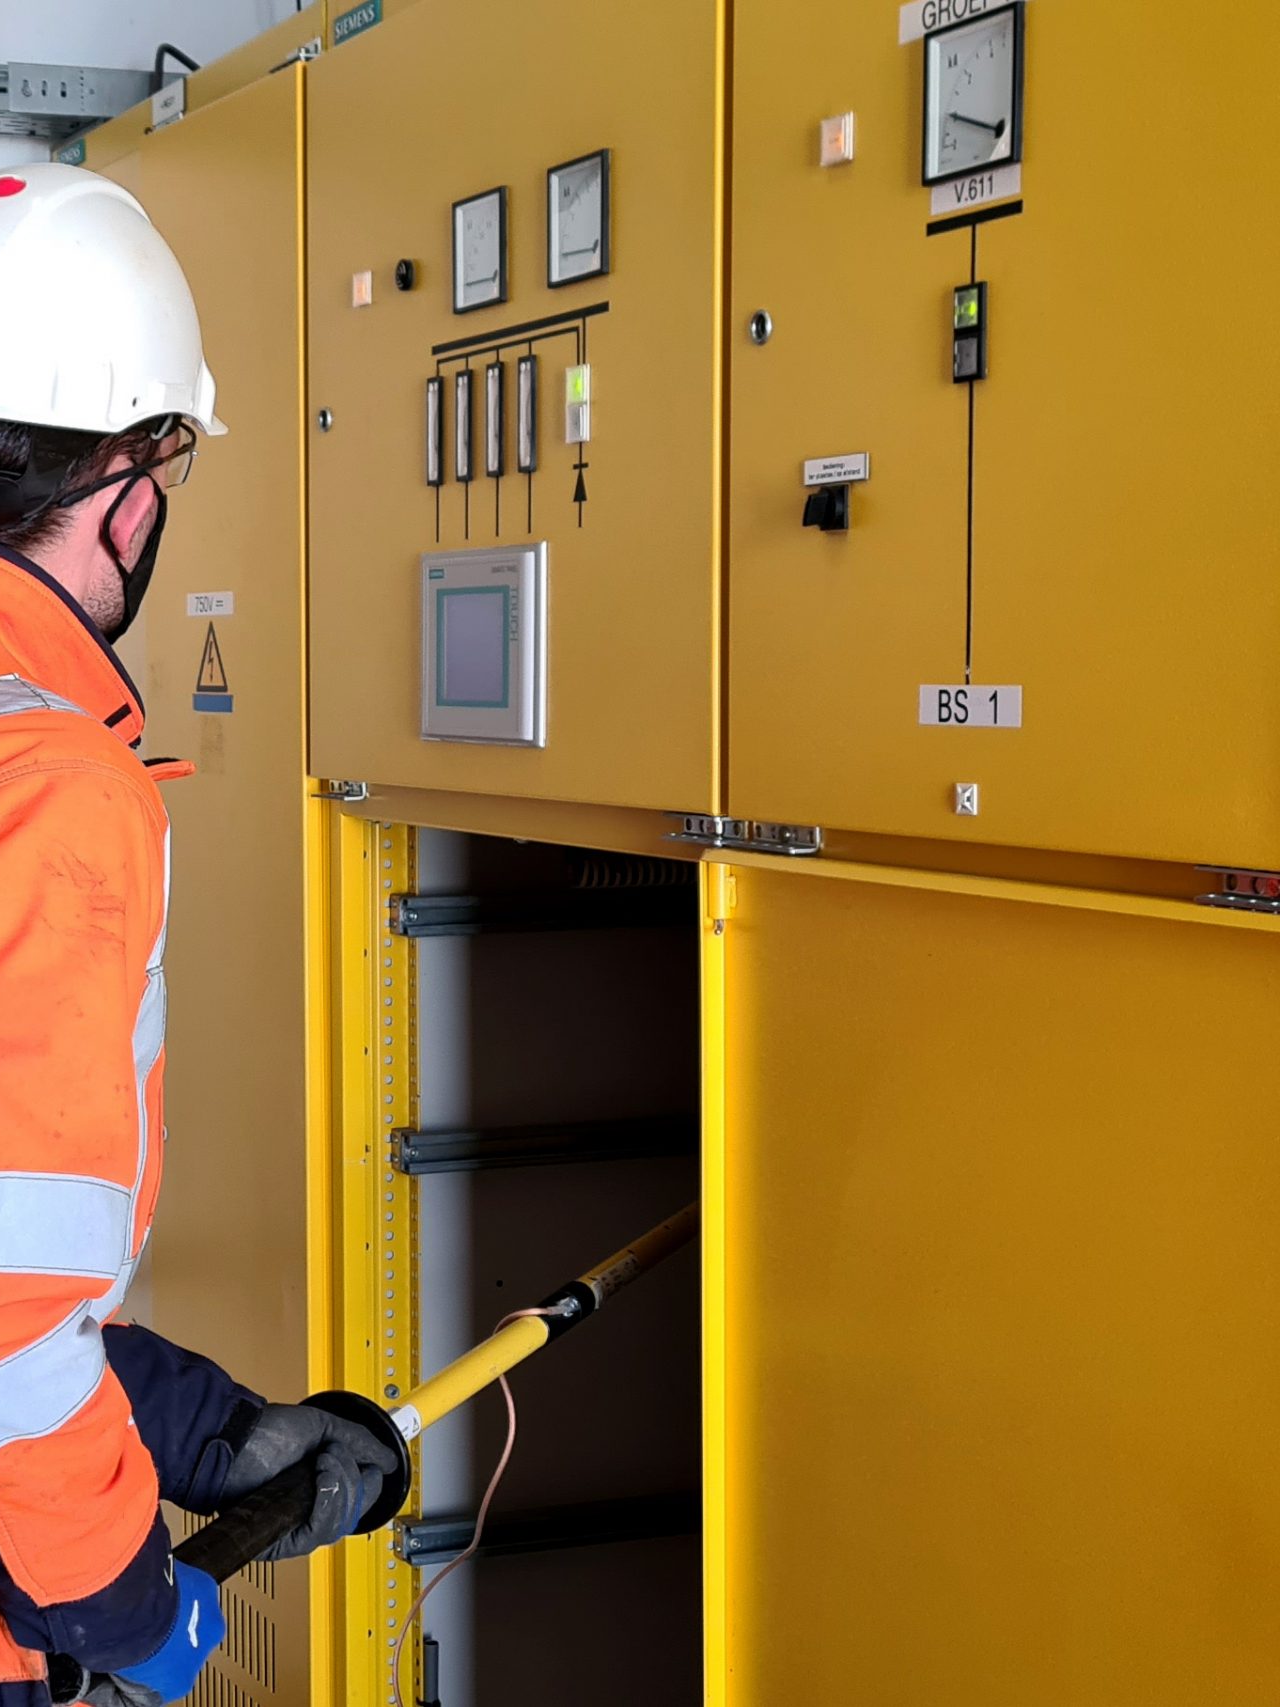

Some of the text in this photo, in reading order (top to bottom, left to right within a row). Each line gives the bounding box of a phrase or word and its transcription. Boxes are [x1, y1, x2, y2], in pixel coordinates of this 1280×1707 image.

[335, 4, 375, 39] SIEMENS
[954, 173, 993, 203] V.611
[194, 595, 214, 613] 750V
[938, 689, 998, 725] BS 1
